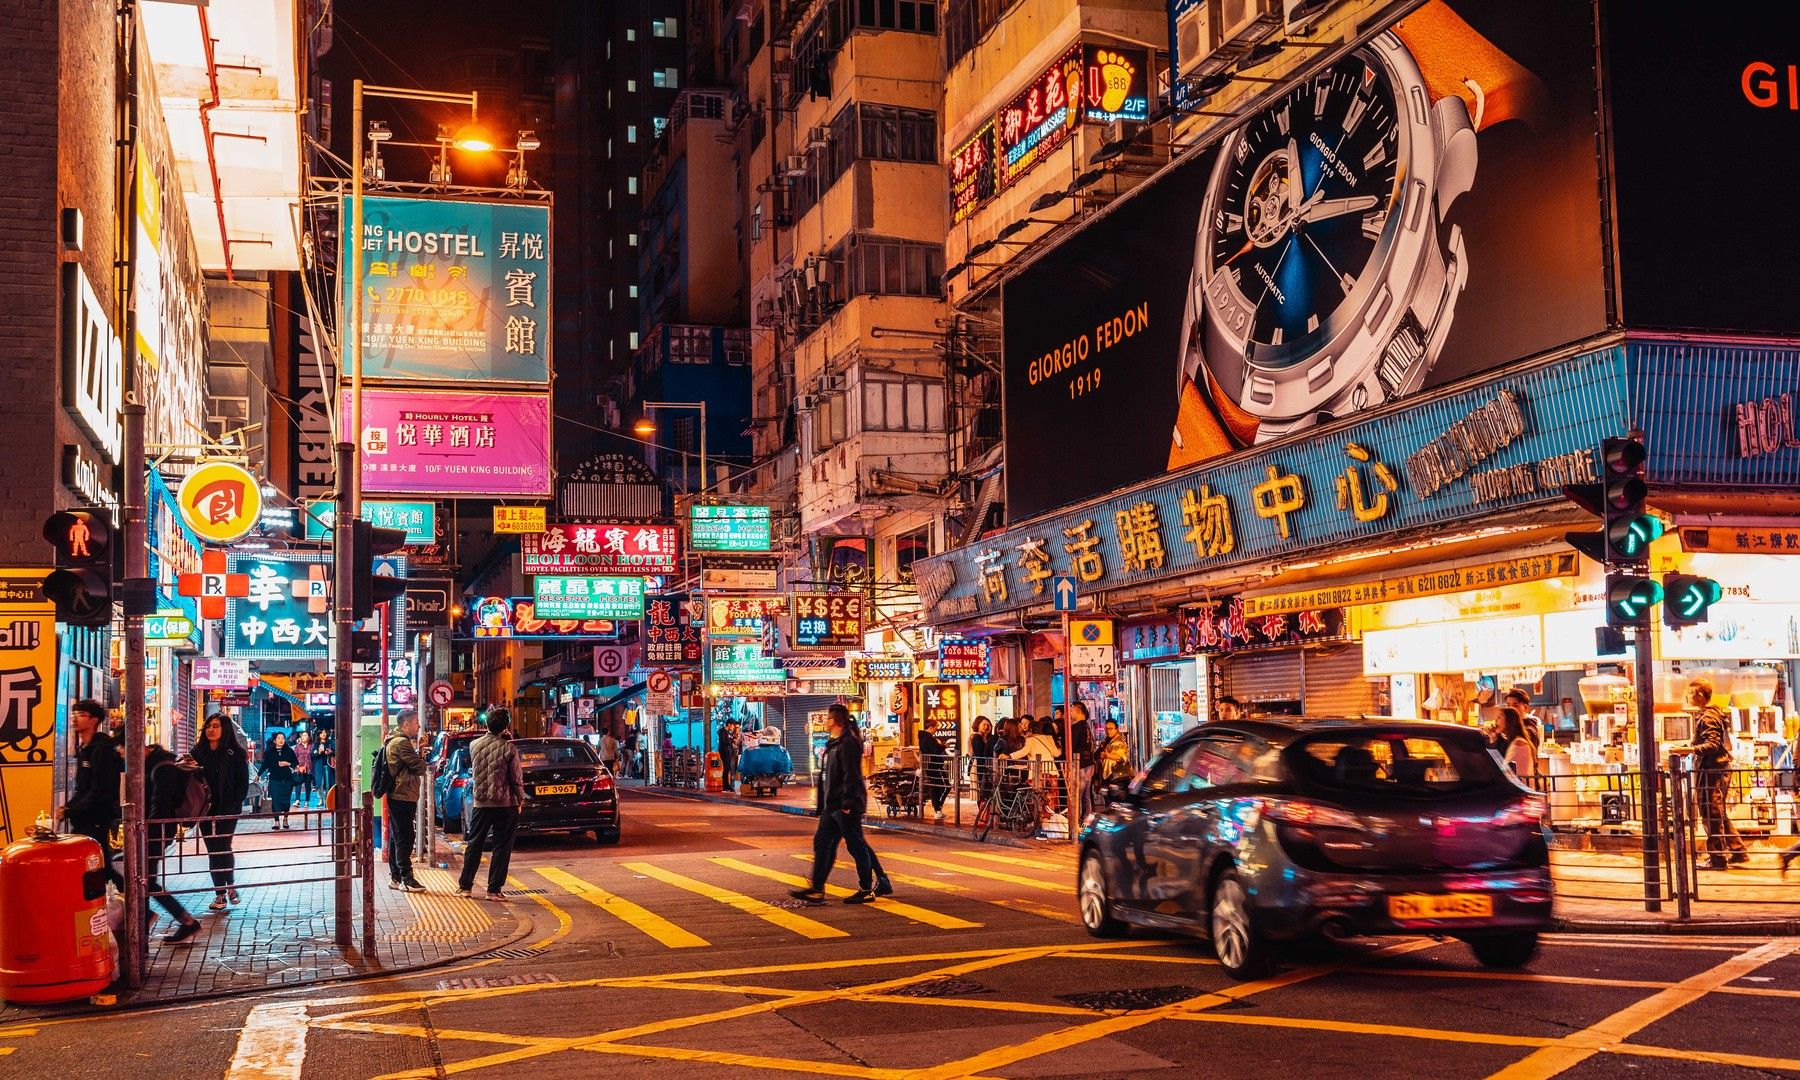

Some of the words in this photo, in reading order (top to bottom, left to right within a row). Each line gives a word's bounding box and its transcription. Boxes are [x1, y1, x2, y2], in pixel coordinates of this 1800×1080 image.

[1124, 99, 1146, 112] 2/F
[1310, 132, 1336, 163] GIORGIO
[1335, 160, 1358, 188] FEDON
[1320, 161, 1334, 178] 1919
[388, 231, 484, 256] HOSTEL
[1254, 262, 1286, 305] AUTOMATIC
[386, 286, 425, 303] 2770
[1214, 281, 1245, 333] 1919
[366, 335, 386, 344] 10/F
[389, 336, 415, 344] YUEN
[418, 337, 440, 346] KING
[443, 338, 486, 348] BUILDING
[1028, 333, 1089, 386] GIORGIO
[1096, 301, 1149, 352] FEDON
[1069, 367, 1101, 400] 1919
[425, 465, 442, 473] 10/F
[444, 465, 468, 474] YUEN
[470, 466, 490, 474] KING
[493, 466, 533, 475] BUILDING
[511, 522, 545, 532] 60380538
[975, 441, 1398, 604] 荷李活購物中心
[541, 527, 660, 555] 海龍賓館
[525, 554, 561, 565] HOI
[563, 554, 613, 565] LOON
[617, 554, 676, 566] HOTEL
[1317, 593, 1332, 605] 6211
[1332, 590, 1351, 604] 8822
[1418, 578, 1436, 592] 6211
[1437, 573, 1462, 590] 8822
[416, 599, 440, 611] hair
[600, 595, 639, 603] HOTEL
[646, 600, 675, 625] 龍
[1098, 647, 1105, 658] 7
[1098, 664, 1112, 674] 12
